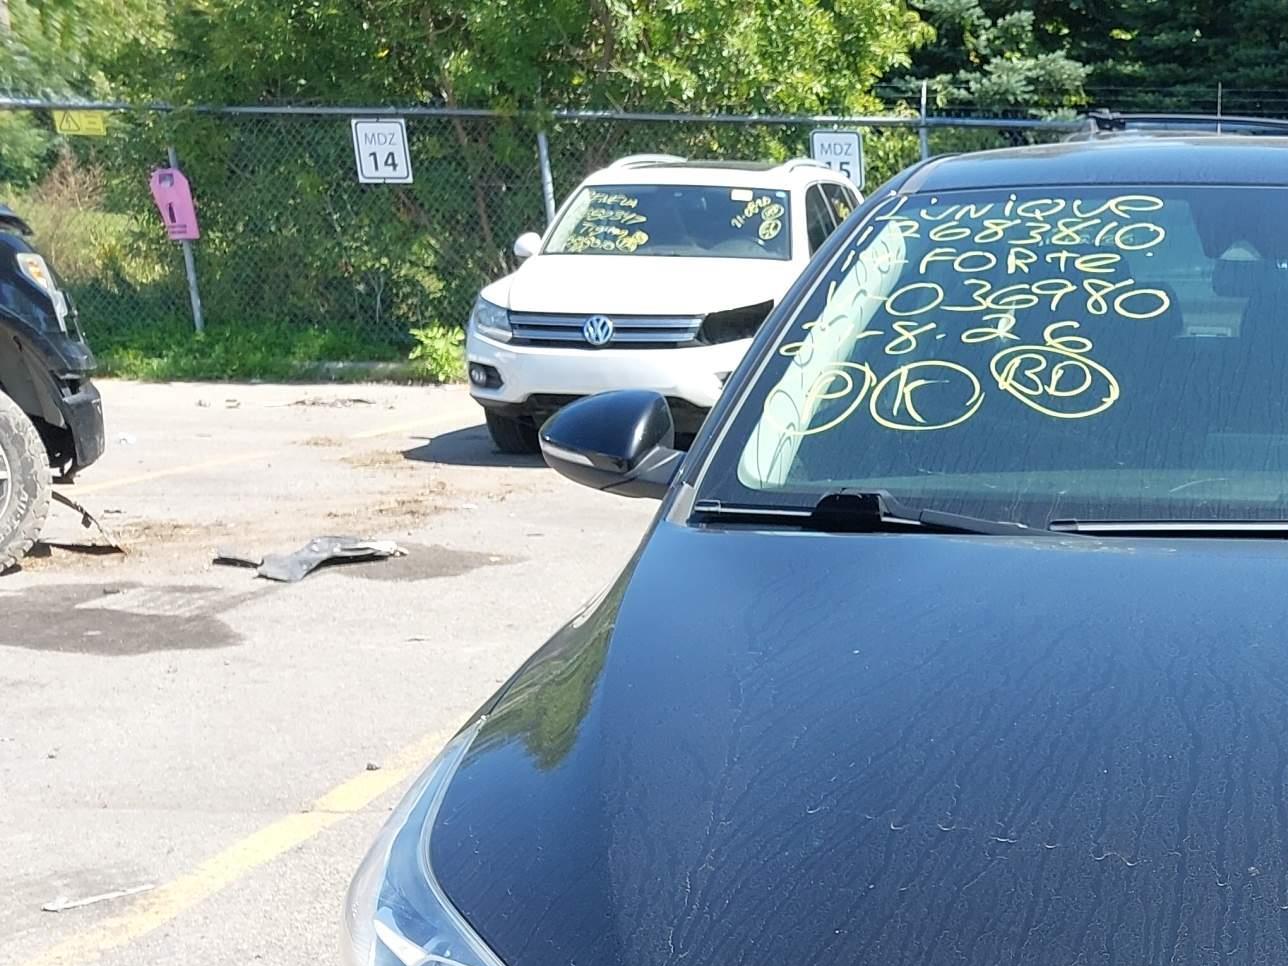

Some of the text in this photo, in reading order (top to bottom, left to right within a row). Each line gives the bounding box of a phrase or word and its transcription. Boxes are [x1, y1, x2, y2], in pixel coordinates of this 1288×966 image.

[364, 132, 397, 147] MDZ
[820, 143, 853, 157] MDZ
[368, 151, 399, 172] 14
